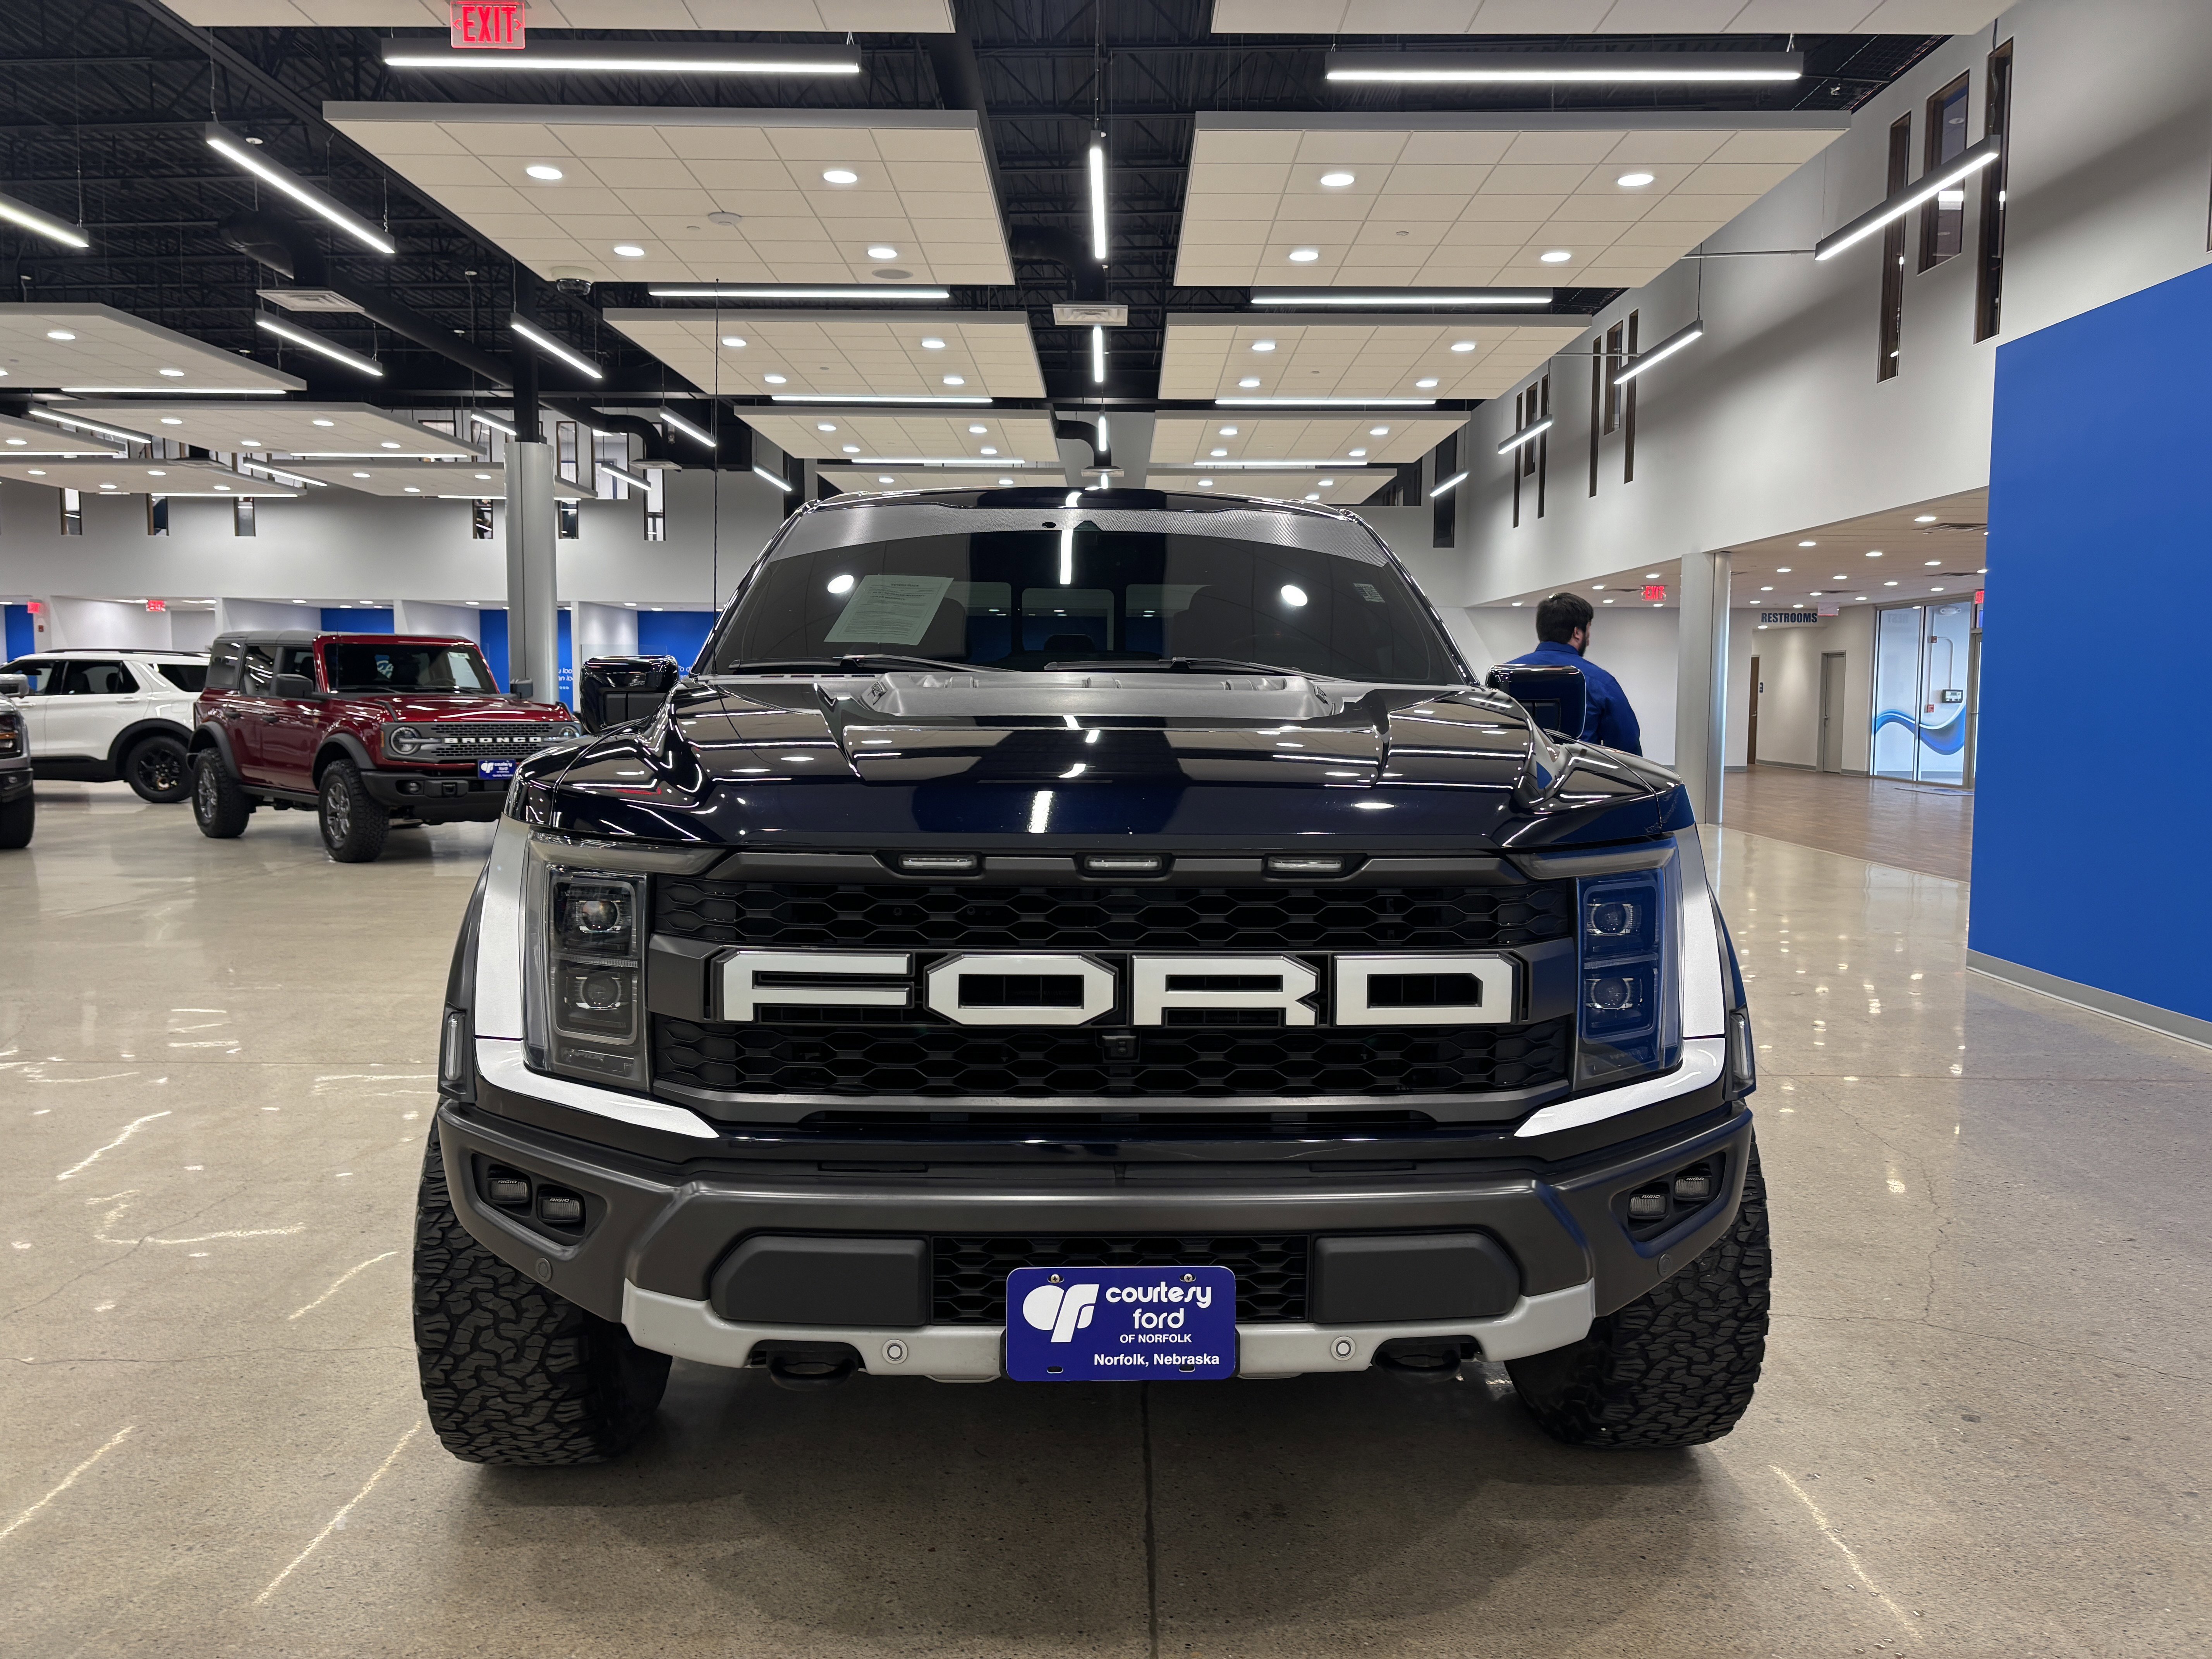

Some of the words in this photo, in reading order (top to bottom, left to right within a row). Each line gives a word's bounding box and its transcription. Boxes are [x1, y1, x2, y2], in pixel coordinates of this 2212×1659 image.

[462, 5, 517, 43] EXIT
[1645, 586, 1664, 599] EXIT
[1761, 613, 1817, 623] RESTROOMS
[723, 950, 1515, 1027] FORD
[1106, 1281, 1211, 1309] courtesy
[1133, 1308, 1184, 1329] ford
[1120, 1334, 1135, 1343] OF
[1138, 1334, 1192, 1343] NORFOLK
[1094, 1353, 1149, 1367] Norfolk,
[1153, 1353, 1220, 1365] Nebraska
